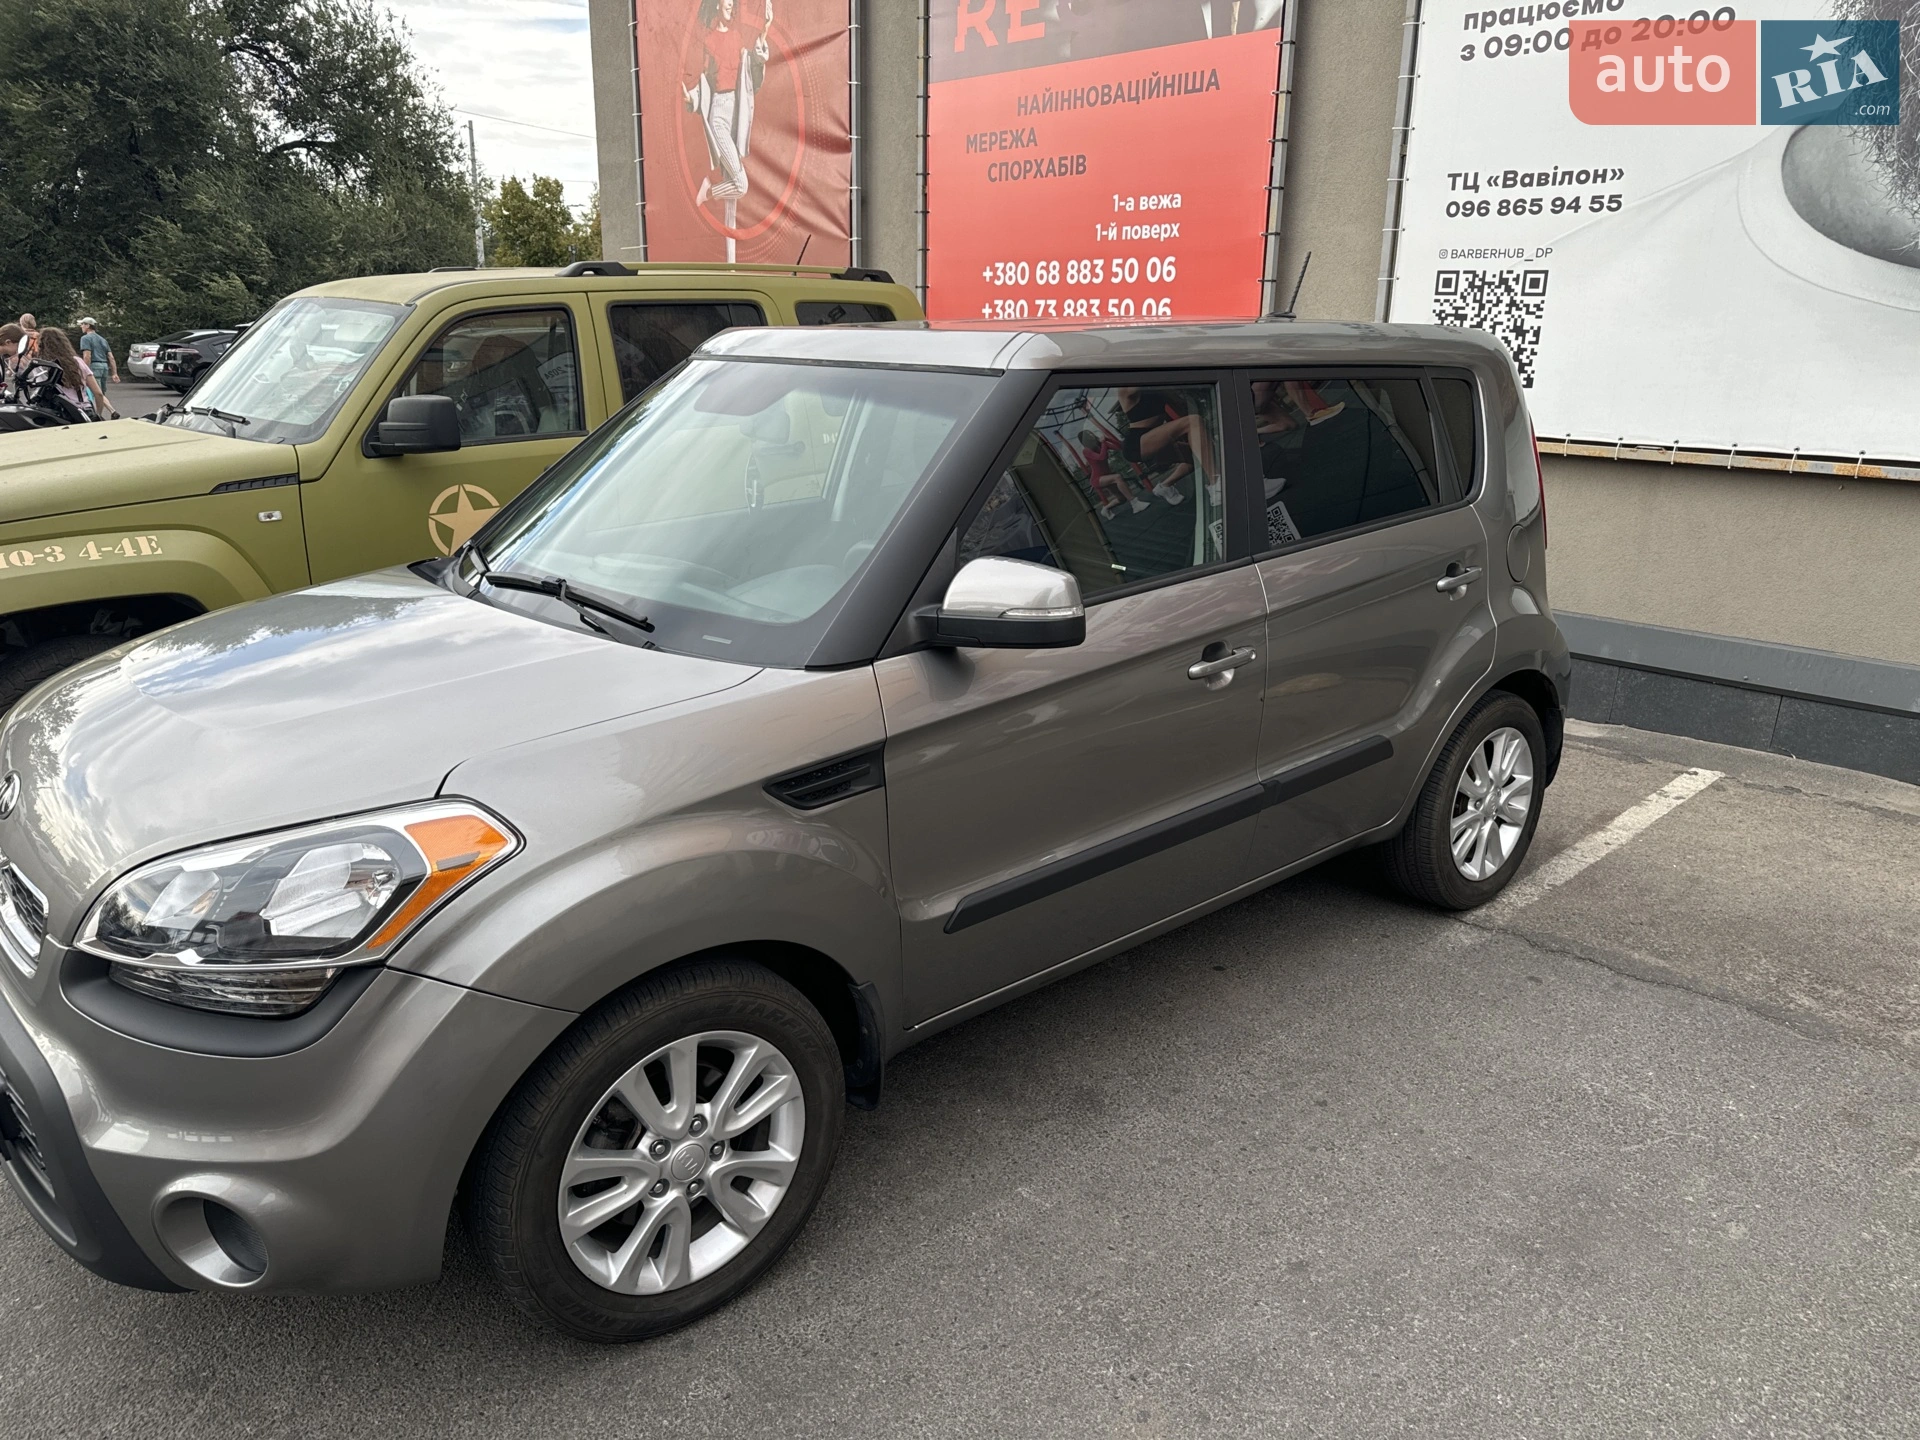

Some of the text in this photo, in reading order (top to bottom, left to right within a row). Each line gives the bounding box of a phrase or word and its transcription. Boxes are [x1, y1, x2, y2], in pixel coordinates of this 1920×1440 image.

[1460, 6, 1737, 62] з 09:00 до 20:00
[1016, 68, 1220, 117] НАЙІННОВАЦІЙНІША
[966, 127, 1038, 154] МЕРЕЖА
[987, 154, 1087, 183] СПОРХАБІВ
[1447, 166, 1625, 193] ТЦ «Вавілон»
[1112, 193, 1182, 213] 1-а вежа
[1445, 193, 1623, 218] 096 865 94 55
[1095, 222, 1181, 243] 1-й поверх
[1450, 248, 1553, 262] BARBERHUB_DP
[982, 256, 1177, 286] +380 68 883 50 06
[981, 297, 1172, 319] +380 73 883 50 06
[78, 535, 163, 561] 4-4E
